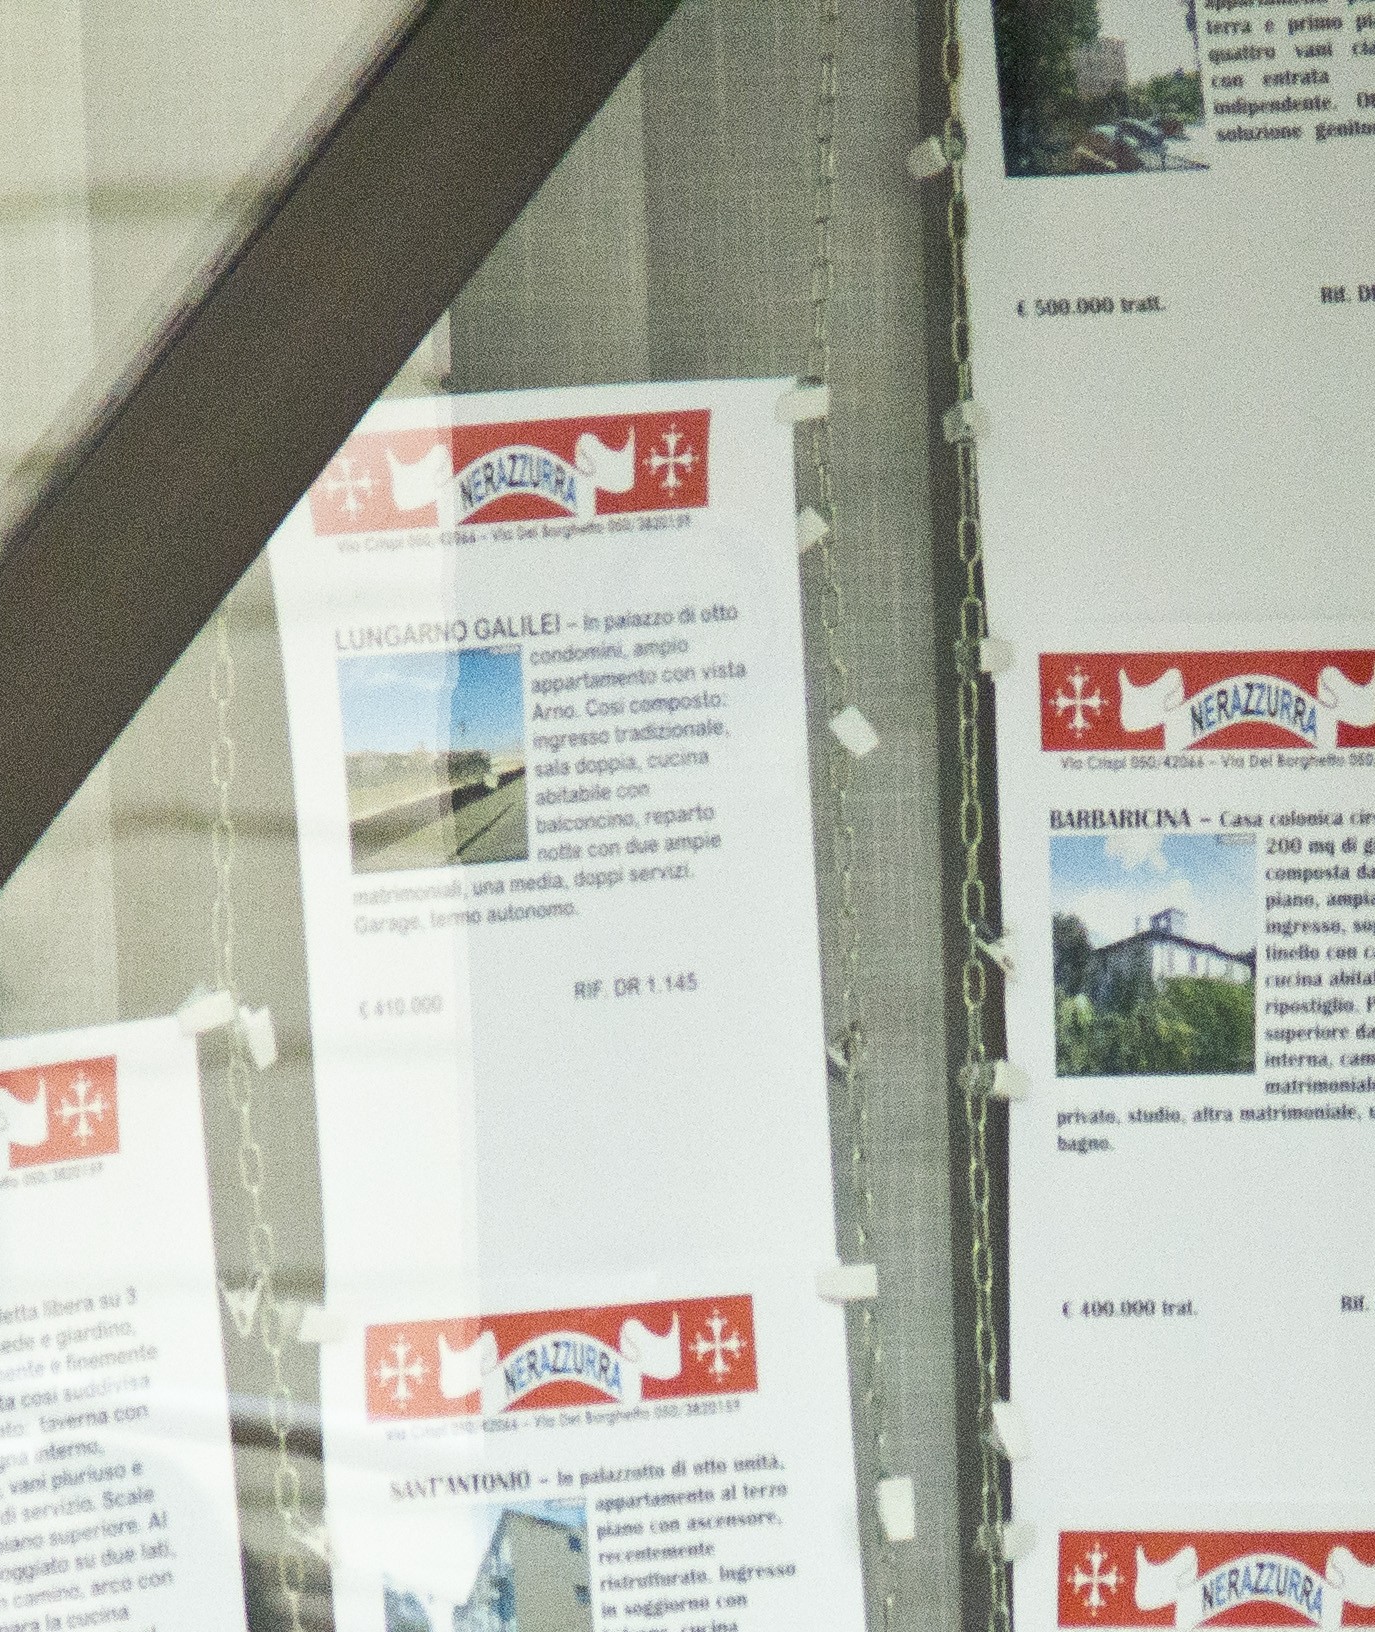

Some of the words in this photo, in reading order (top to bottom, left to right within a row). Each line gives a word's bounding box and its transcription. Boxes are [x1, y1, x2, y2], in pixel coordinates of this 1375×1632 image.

[458, 448, 578, 511] NERAZZURRA
[474, 612, 563, 642] GALILEI
[1190, 682, 1318, 737] NERAZZURRA
[1049, 807, 1193, 830] BARBARICINA
[1218, 810, 1263, 830] Casa
[504, 1340, 621, 1398] NERAZZURRA
[1202, 1560, 1324, 1615] NERAZZURRA
